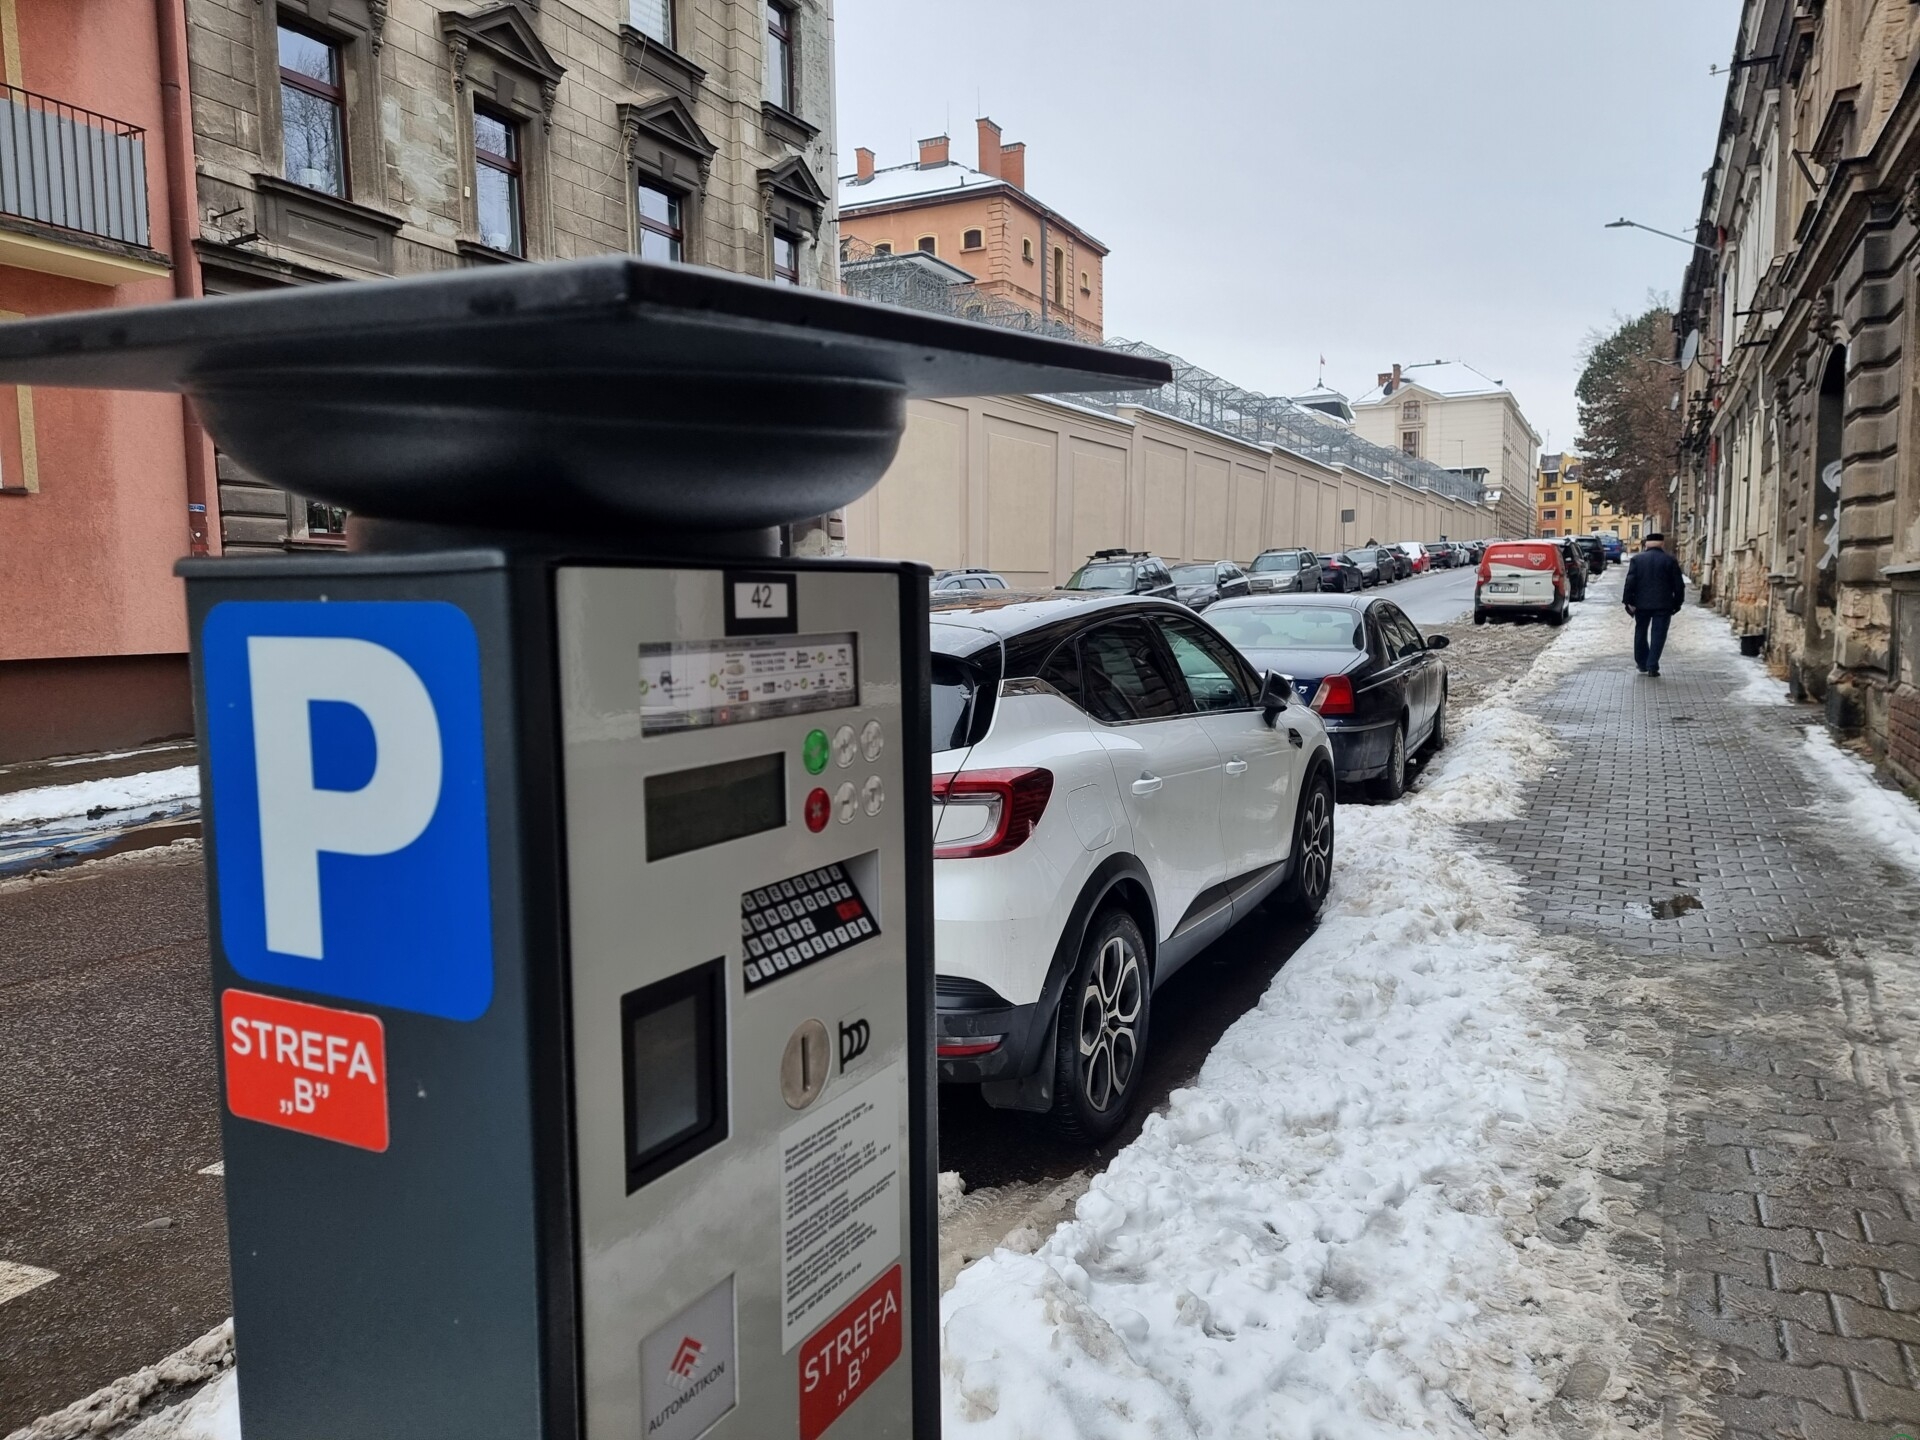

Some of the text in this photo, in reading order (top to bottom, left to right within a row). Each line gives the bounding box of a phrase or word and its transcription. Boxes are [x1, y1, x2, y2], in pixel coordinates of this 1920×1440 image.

[751, 584, 772, 608] 42
[247, 636, 443, 960] P
[231, 1016, 377, 1085] STREFA
[804, 1289, 898, 1393] STREFA
[649, 1361, 725, 1435] AUTOMATIKON
